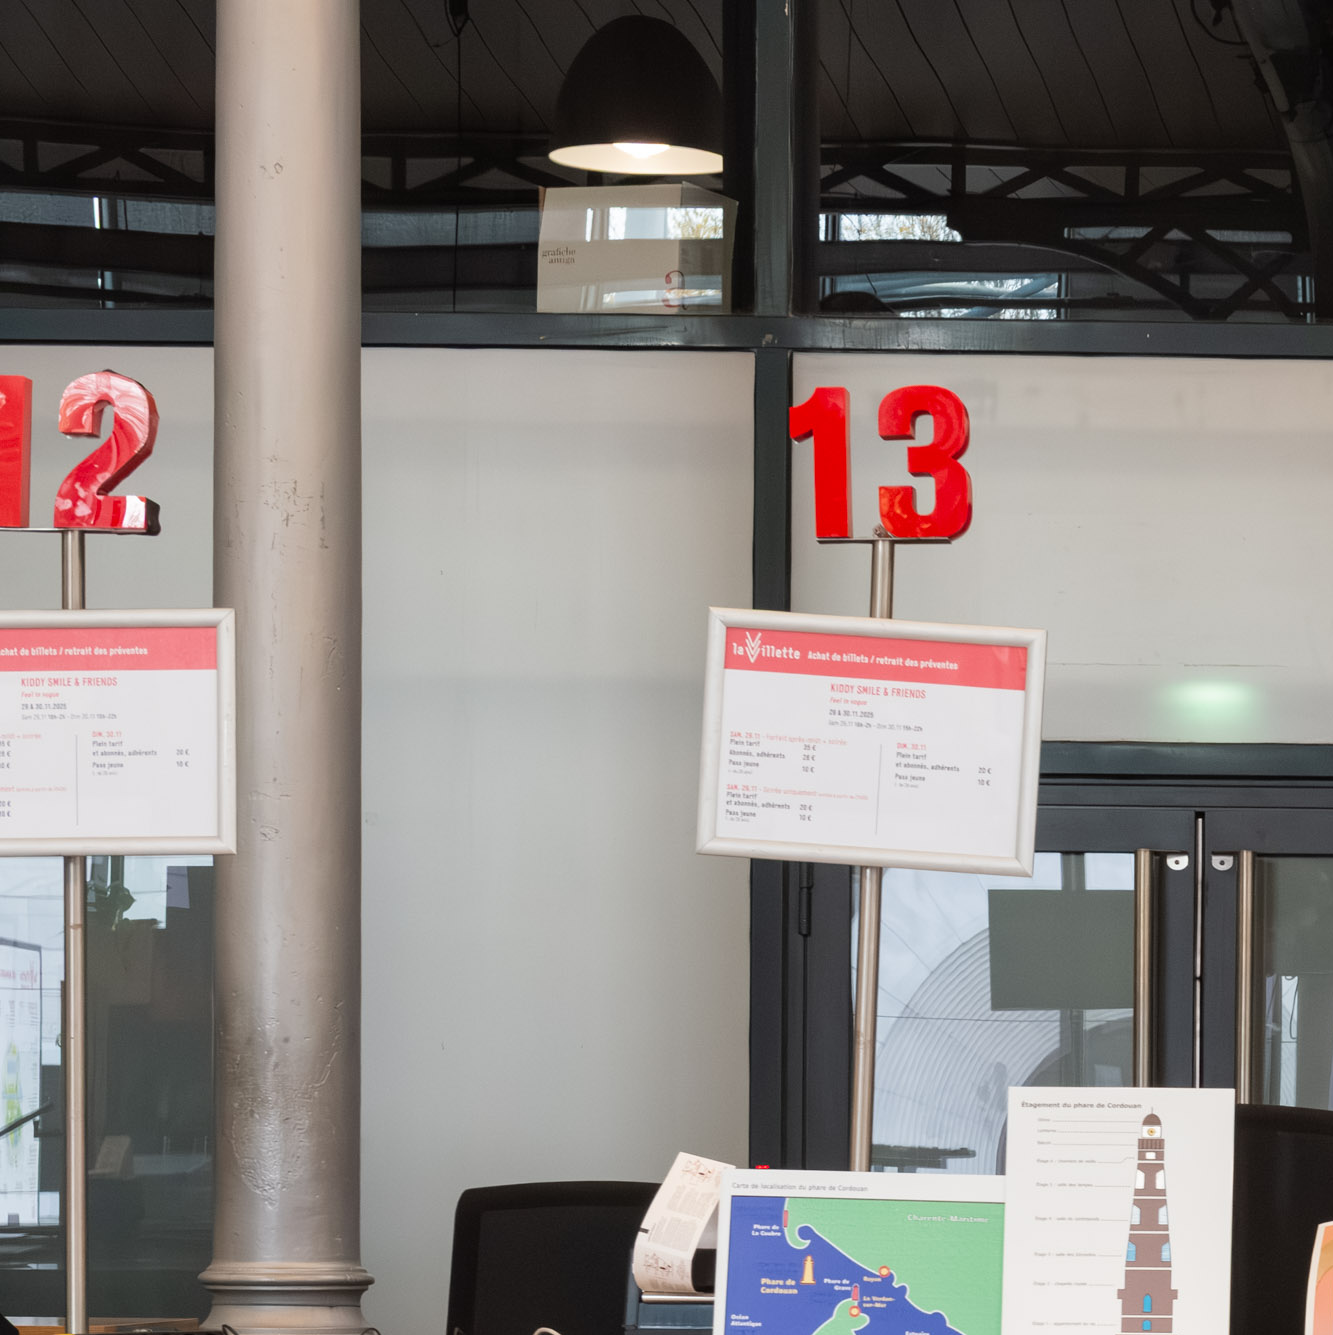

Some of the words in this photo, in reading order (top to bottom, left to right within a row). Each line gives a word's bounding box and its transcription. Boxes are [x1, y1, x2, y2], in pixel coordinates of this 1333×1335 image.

[0, 369, 161, 536] 12
[789, 385, 973, 540] 13
[0, 647, 18, 656] chat
[808, 651, 830, 661] Achat
[831, 653, 841, 662] de
[842, 653, 869, 664] billets
[870, 655, 875, 665] /
[876, 655, 903, 666] retrait
[904, 657, 919, 668] des
[920, 659, 959, 671] préventes
[21, 677, 45, 687] KIDDY
[48, 677, 72, 686] SMILE
[74, 677, 80, 686] &
[82, 677, 118, 686] FRIENDS
[830, 683, 854, 694] KIDDY
[857, 685, 881, 696] SMILE
[883, 687, 889, 696] &
[891, 687, 926, 699] FRIENDS
[1021, 1101, 1061, 1109] Étagement
[761, 1183, 796, 1191] localisation
[808, 1184, 826, 1193] phare
[760, 1278, 784, 1286] Phare
[760, 1286, 798, 1295] Cordouan
